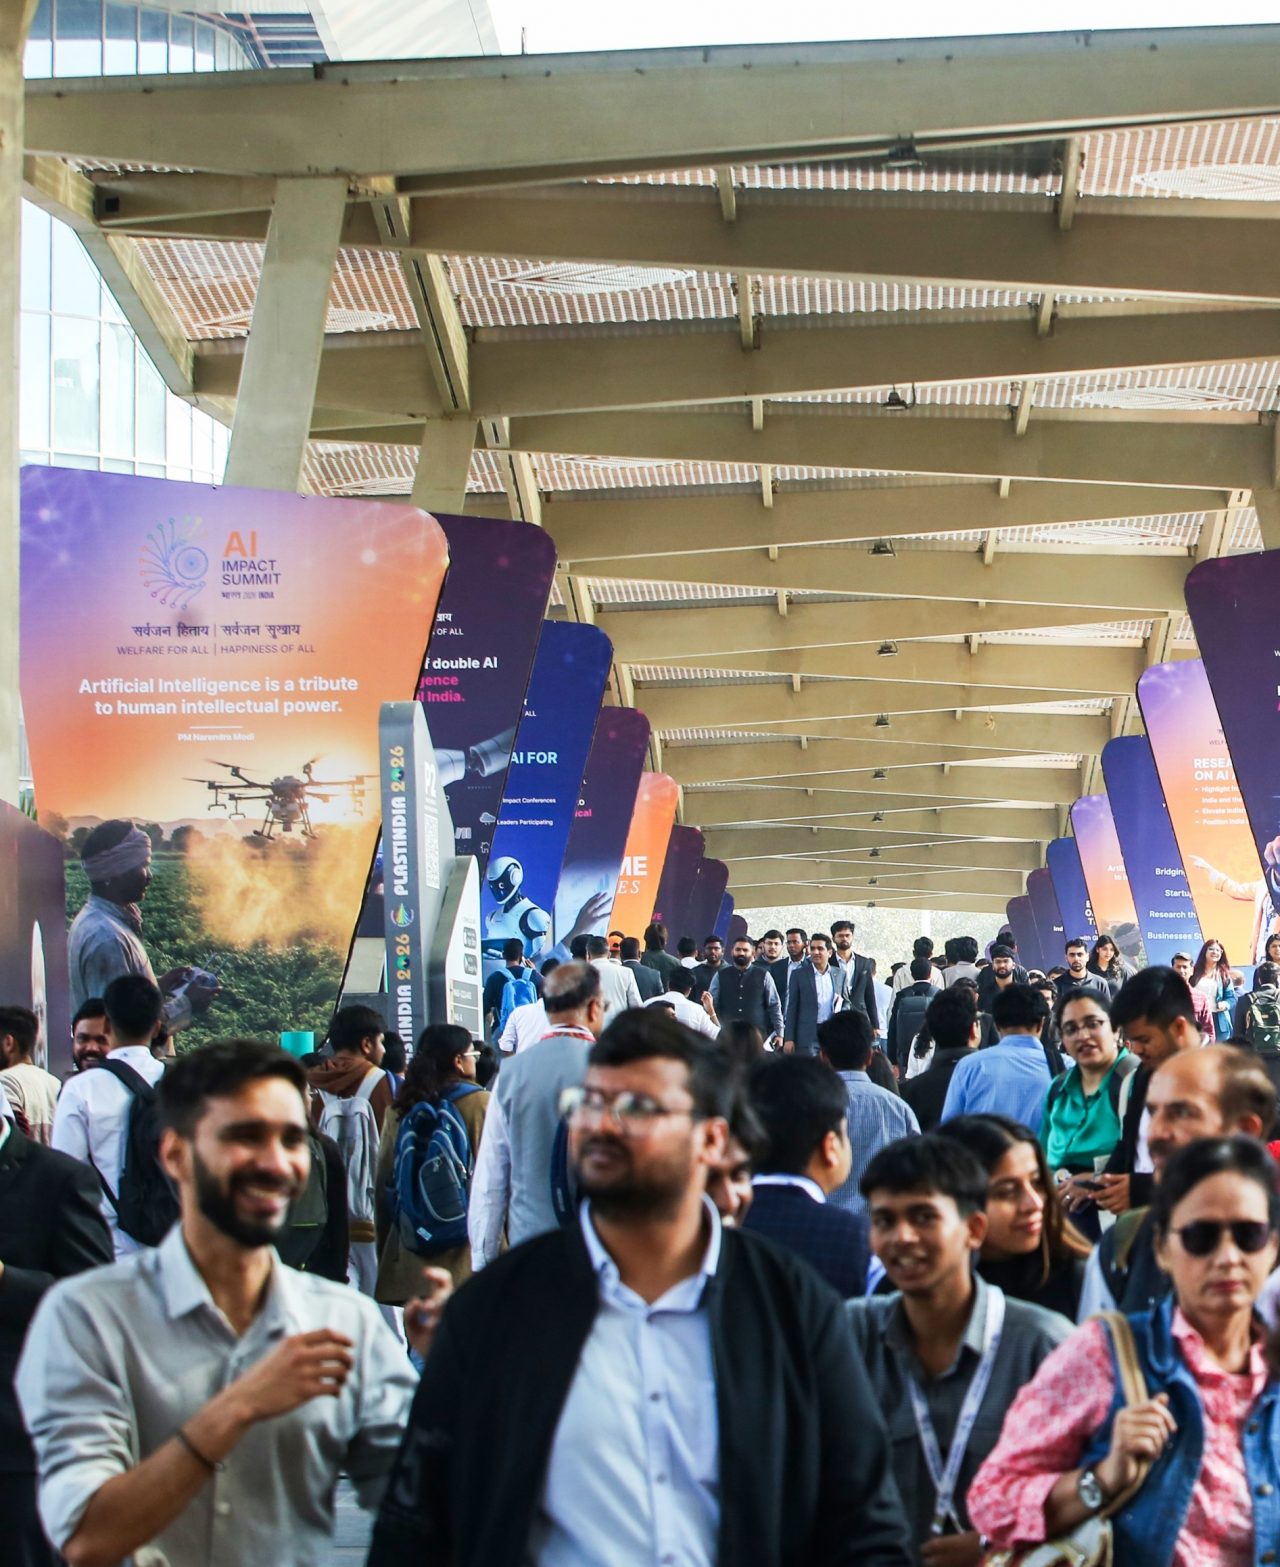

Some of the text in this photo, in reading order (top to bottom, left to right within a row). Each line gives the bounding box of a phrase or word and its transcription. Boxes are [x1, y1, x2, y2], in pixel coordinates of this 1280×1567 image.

[223, 530, 258, 558] AI
[222, 560, 277, 572] IMPACT
[222, 573, 282, 586] SUMMIT
[131, 622, 301, 639] सर्वजन हिताय सर्वजन सुखाय
[436, 627, 447, 636] OF
[449, 627, 464, 636] ALL
[116, 644, 316, 656] WELFARE FOR ALL HAPPINESS OF ALL
[432, 657, 480, 670] double
[483, 656, 498, 669] AI
[79, 676, 359, 696] Artificial Intelligence is a tribute
[427, 690, 465, 702] India.
[94, 698, 343, 717] to human intellectual power.
[177, 732, 256, 742] PM Narendra Modi
[527, 752, 558, 764] FOR
[1193, 757, 1234, 769] RESEA
[1194, 770, 1213, 781] ON
[1216, 770, 1229, 781] AI
[1201, 786, 1230, 794] Highlight
[502, 797, 521, 805] Impact
[519, 819, 554, 827] Participating
[392, 796, 409, 896] PLASTINDIA
[1149, 910, 1186, 919] Research
[1147, 931, 1192, 940] Businesses
